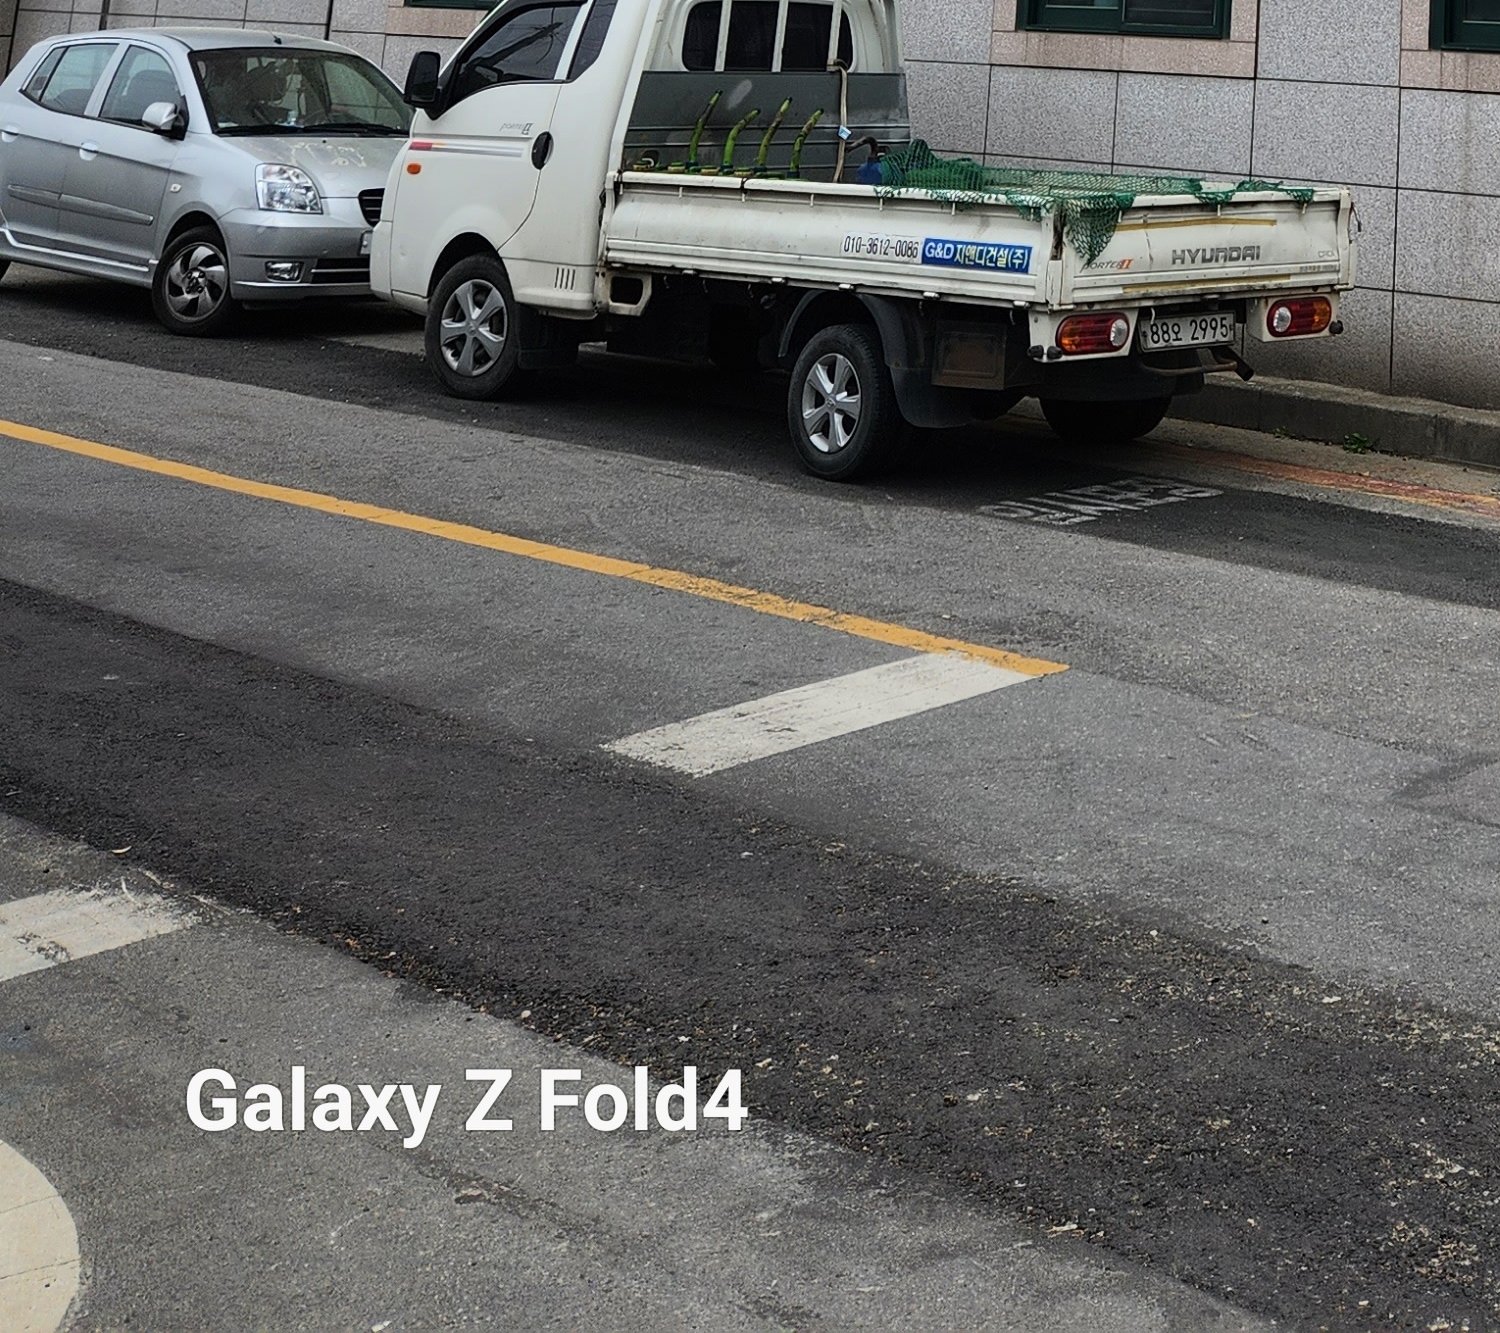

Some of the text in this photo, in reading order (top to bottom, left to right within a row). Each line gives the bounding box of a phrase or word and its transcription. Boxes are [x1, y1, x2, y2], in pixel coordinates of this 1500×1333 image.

[843, 235, 920, 259] 010-3612-0086
[924, 241, 1028, 270] G&D 지앤디건설(주)
[1171, 245, 1261, 266] HYUNDAI
[1149, 316, 1229, 345] 88오 2995
